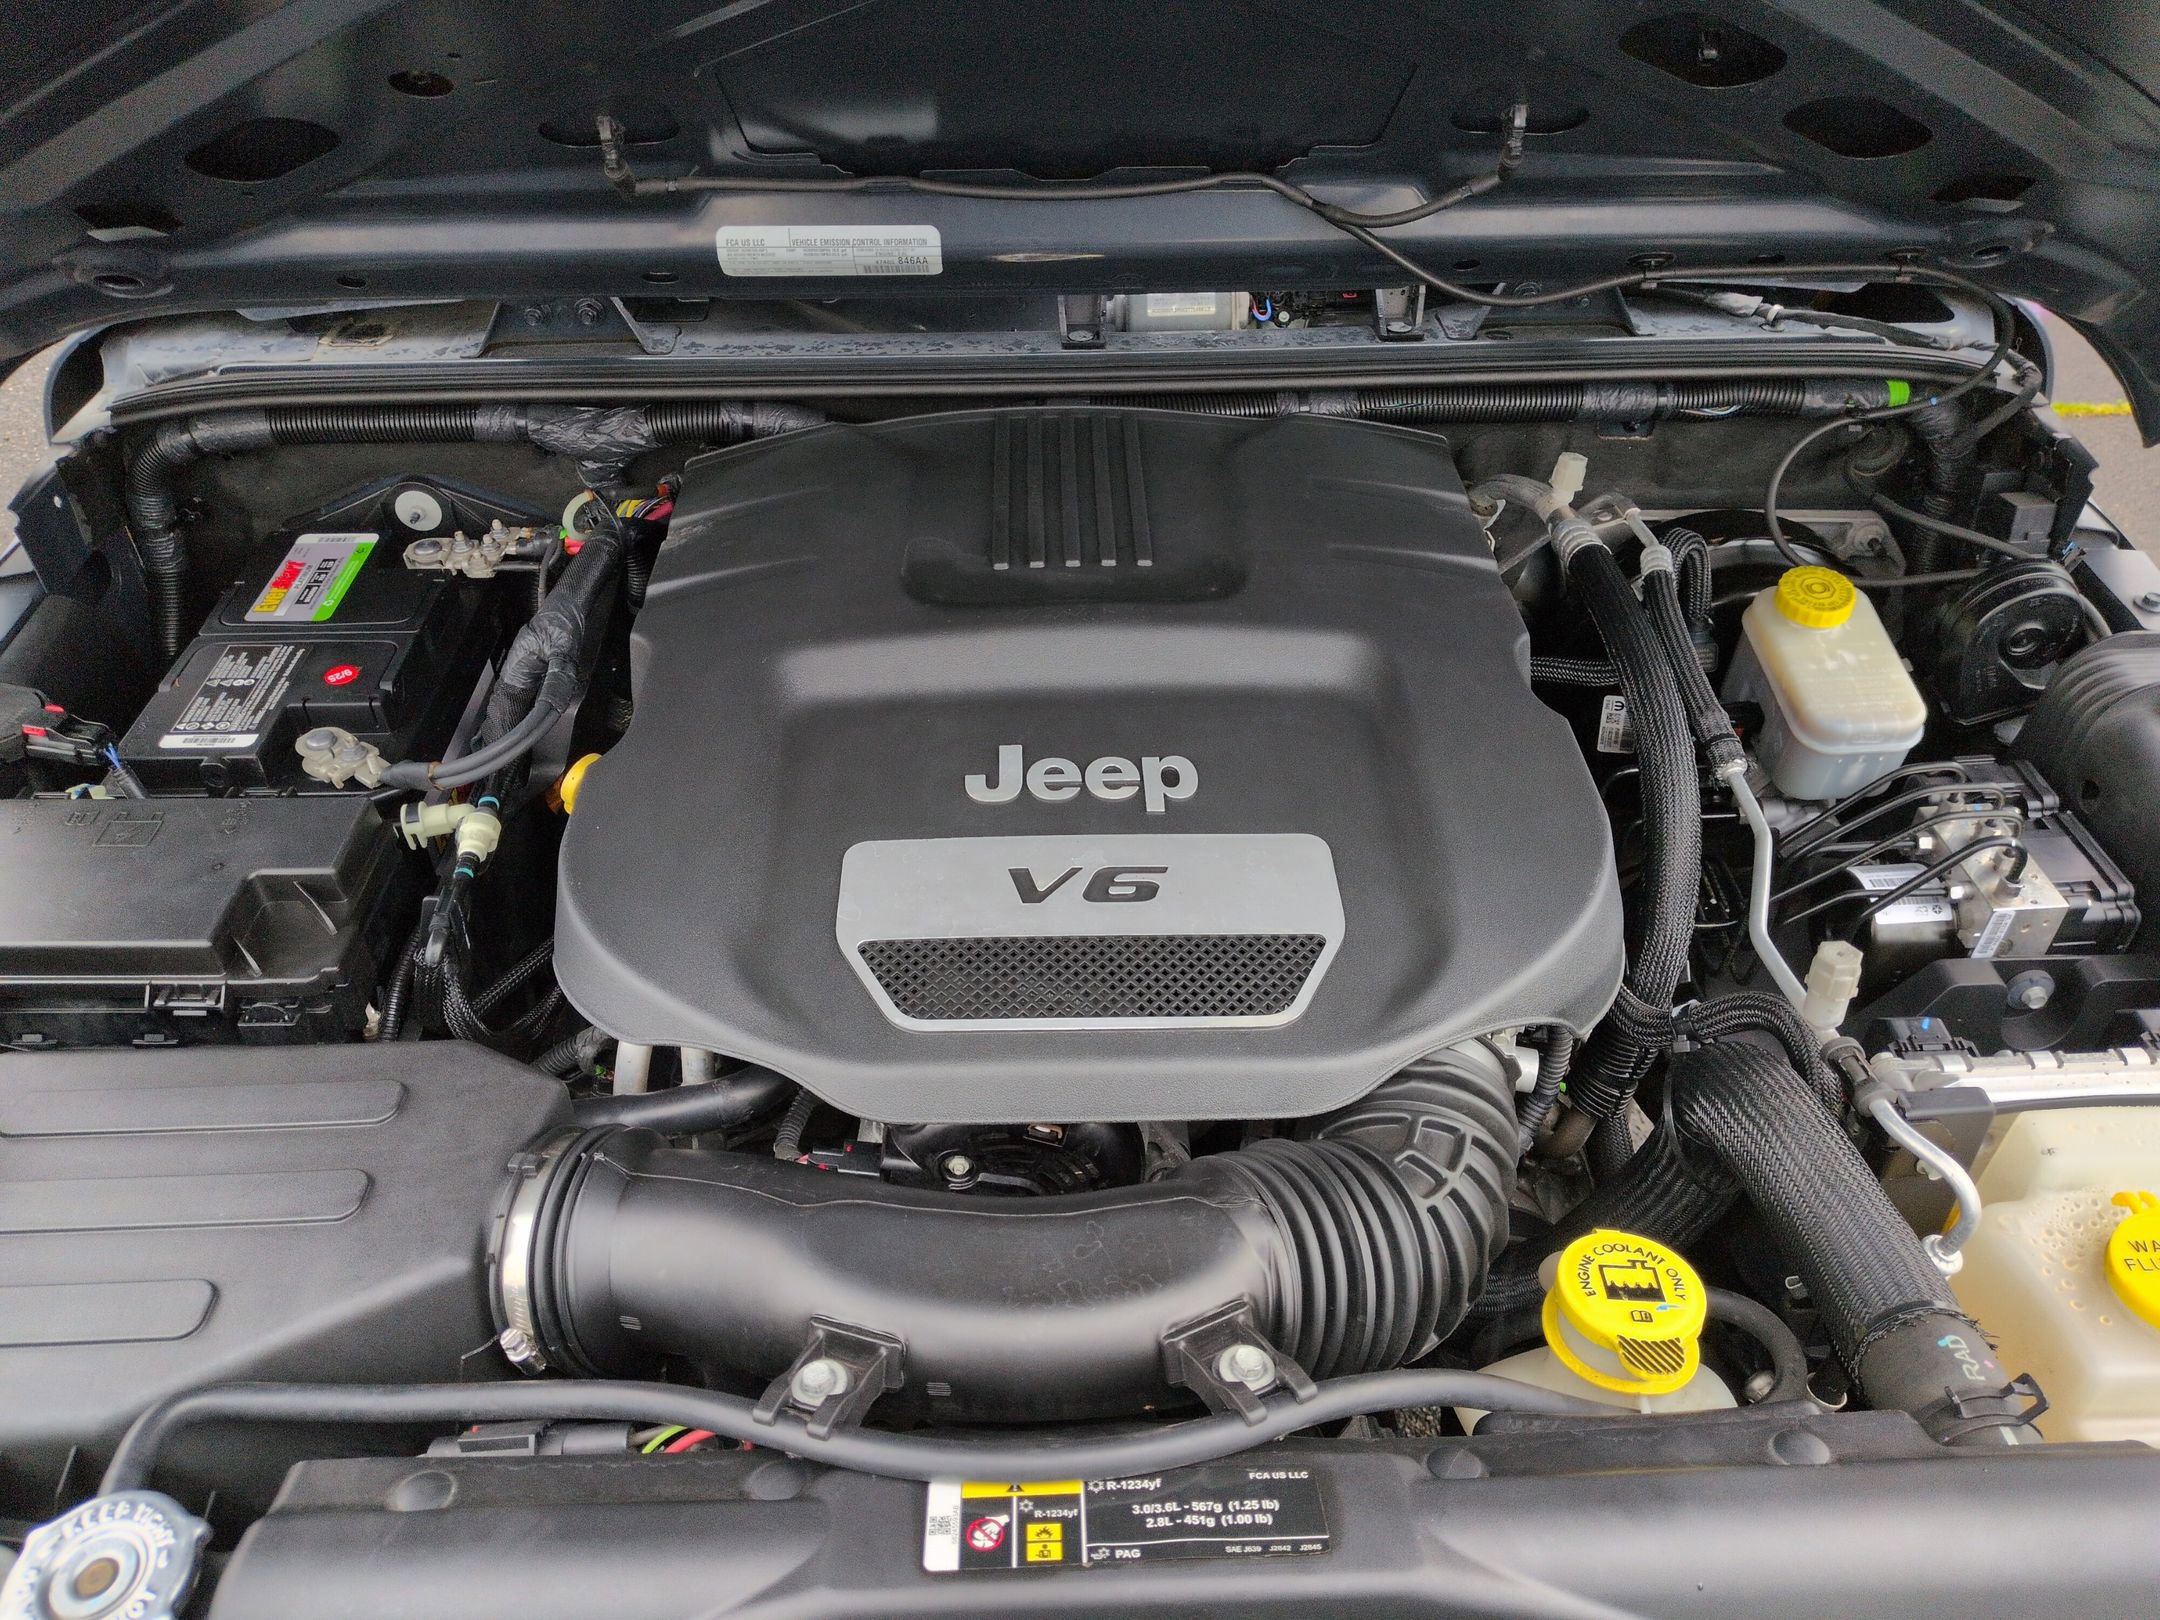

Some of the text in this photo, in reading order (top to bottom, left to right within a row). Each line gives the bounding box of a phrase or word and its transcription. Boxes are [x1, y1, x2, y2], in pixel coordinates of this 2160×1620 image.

[726, 238, 765, 247] FCA US LLC
[792, 238, 928, 247] VEHICLE EMISSION CONTROL INFORMATION
[898, 256, 928, 265] 846AA
[964, 744, 1199, 815] Jeep
[1008, 866, 1169, 904] V6
[1577, 1243, 1686, 1300] ENGINE COOLANT ONLY
[1948, 1335, 1986, 1381] RAD
[1249, 1470, 1309, 1480] FCA US LLC
[1106, 1478, 1162, 1492] R-1234yf
[1132, 1503, 1181, 1514] 3.0/3.6L
[1191, 1501, 1223, 1512] 567g
[1228, 1500, 1259, 1512] (1.25
[1261, 1499, 1280, 1511] lb)
[1034, 1509, 1079, 1519] R-1234yf
[1145, 1517, 1174, 1528] 2.8L
[1183, 1515, 1216, 1527] 451g
[1221, 1514, 1252, 1527] (1.00
[1254, 1513, 1273, 1525] lb)
[1115, 1549, 1141, 1559] PAG
